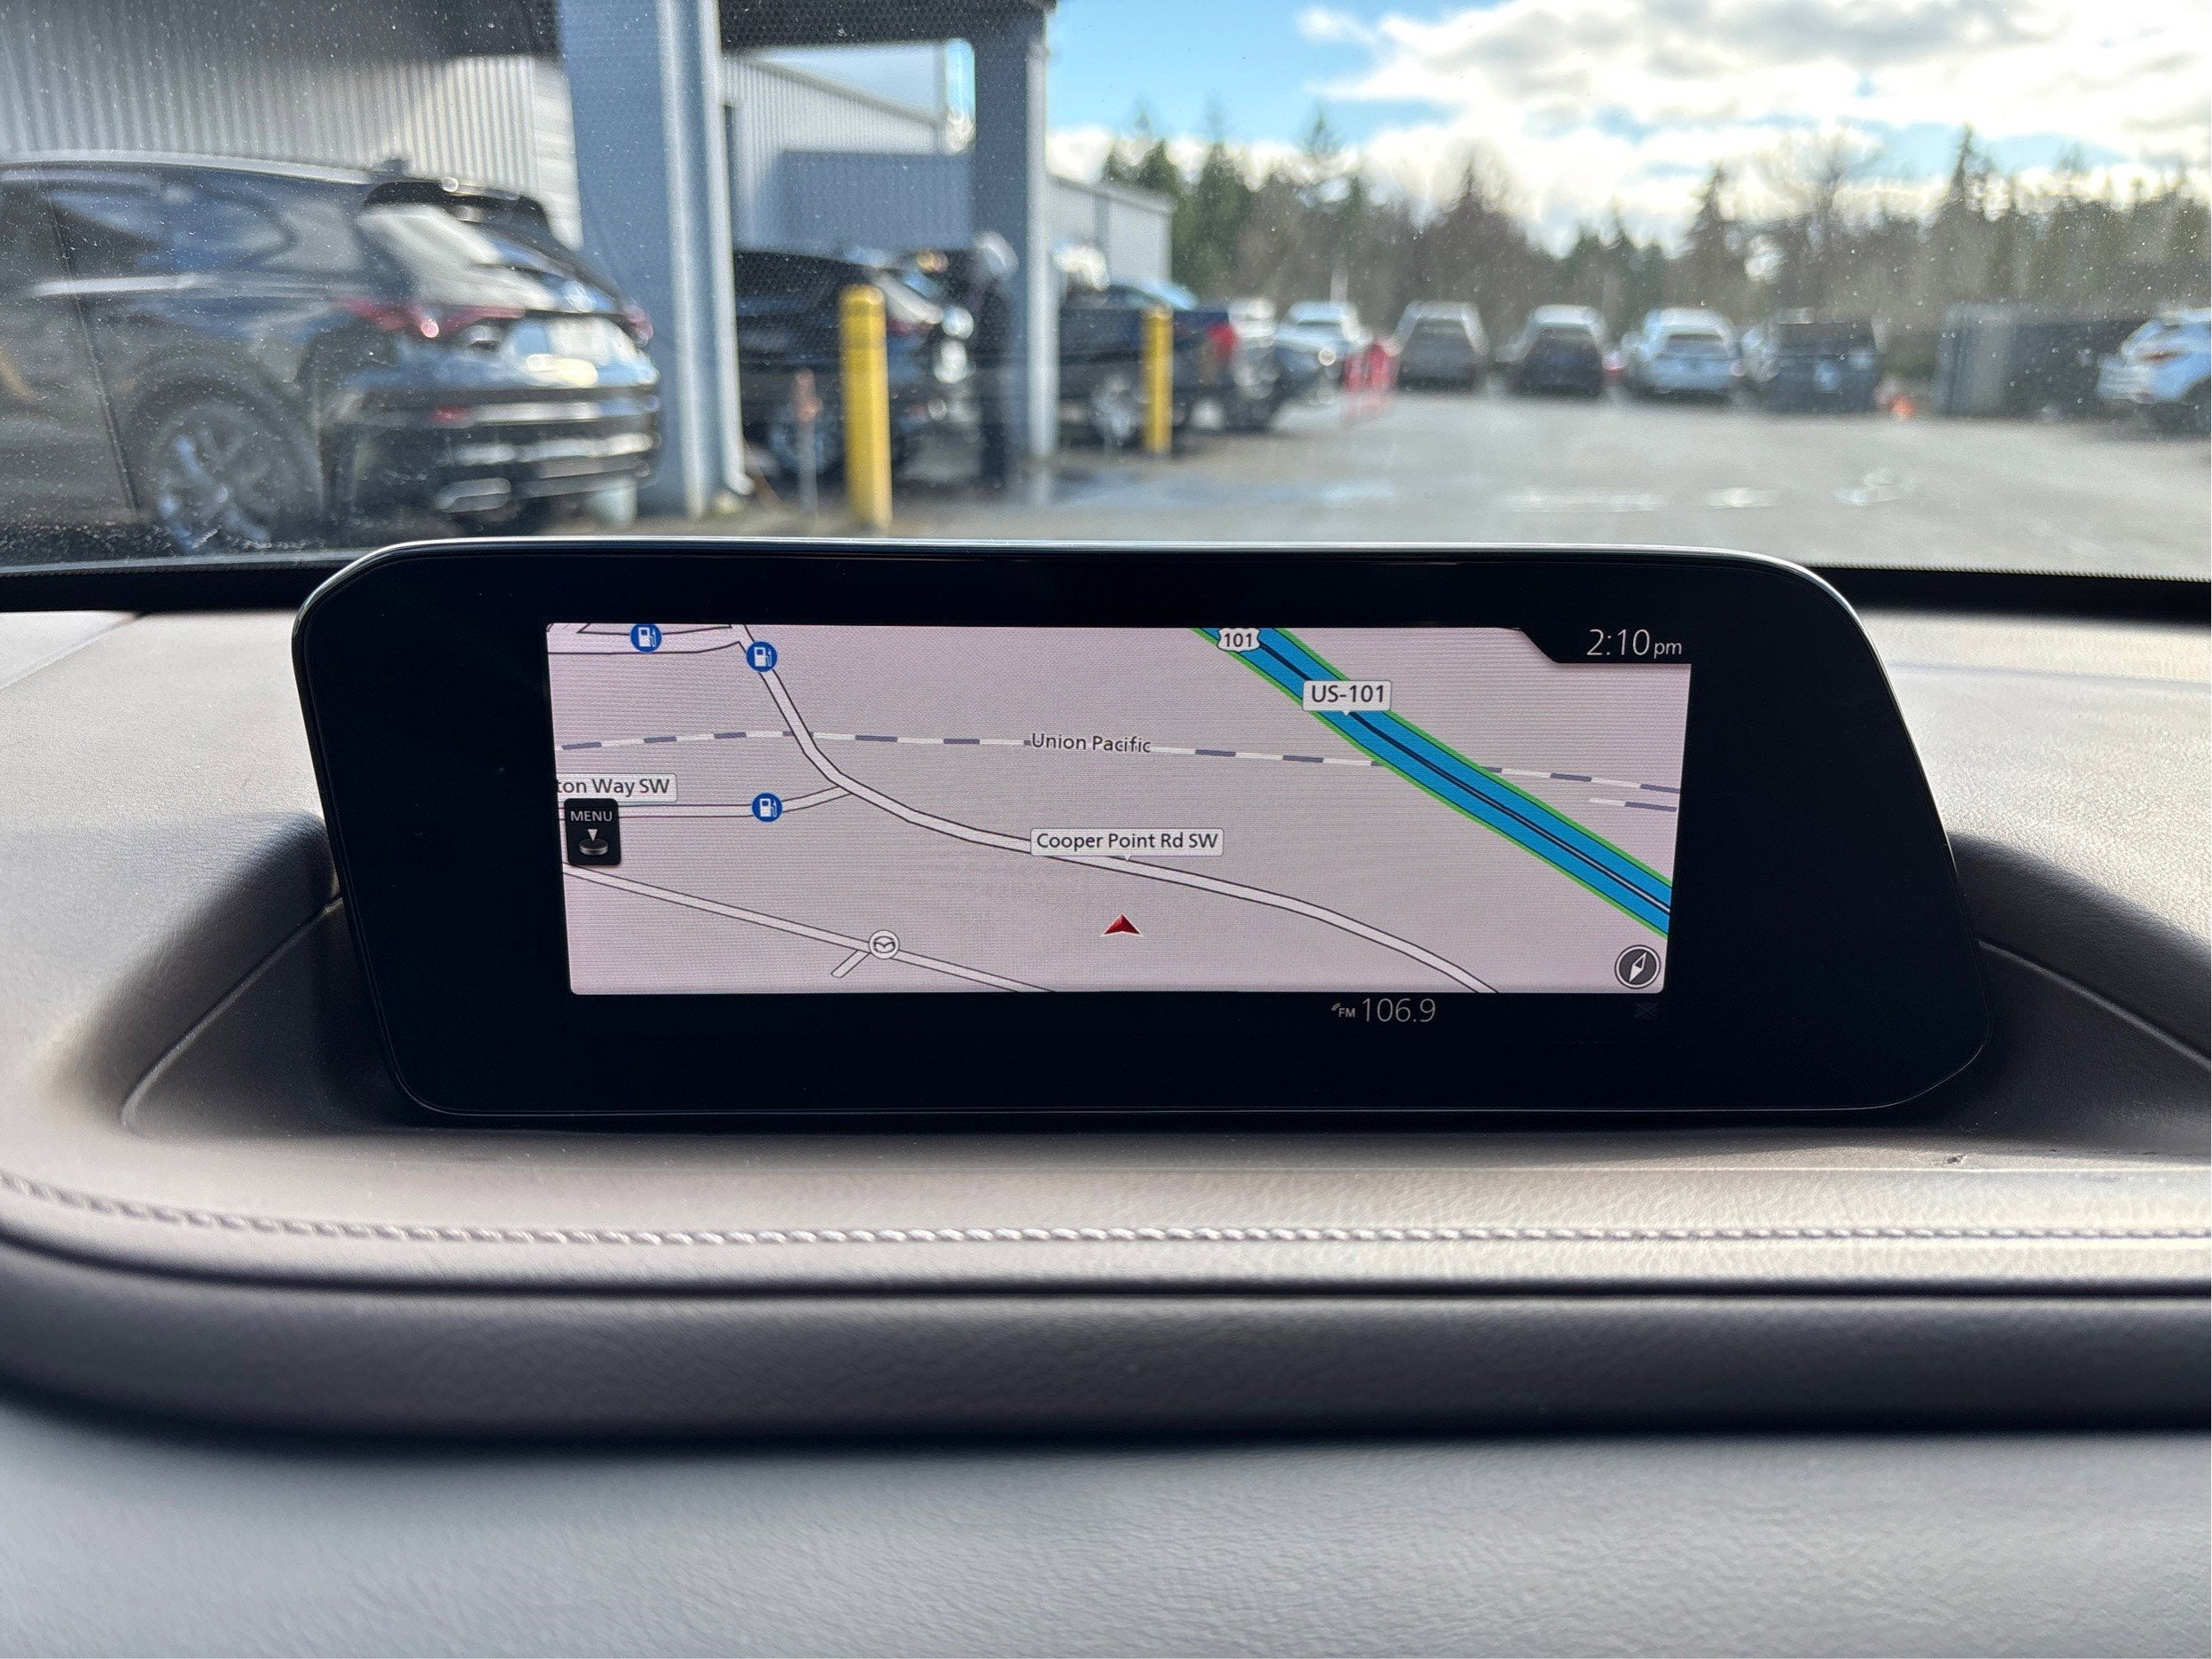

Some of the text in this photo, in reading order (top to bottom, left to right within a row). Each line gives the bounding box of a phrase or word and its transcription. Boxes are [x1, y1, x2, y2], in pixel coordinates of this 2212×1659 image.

[1223, 633, 1253, 648] 101
[1310, 685, 1385, 703] US-101
[1031, 732, 1152, 753] Union Pacific
[591, 779, 636, 798] Way
[639, 779, 670, 794] SW
[570, 810, 613, 822] MENU
[1036, 832, 1219, 852] Cooper Point Rd SW
[1338, 998, 1436, 1023] FM 106.9
